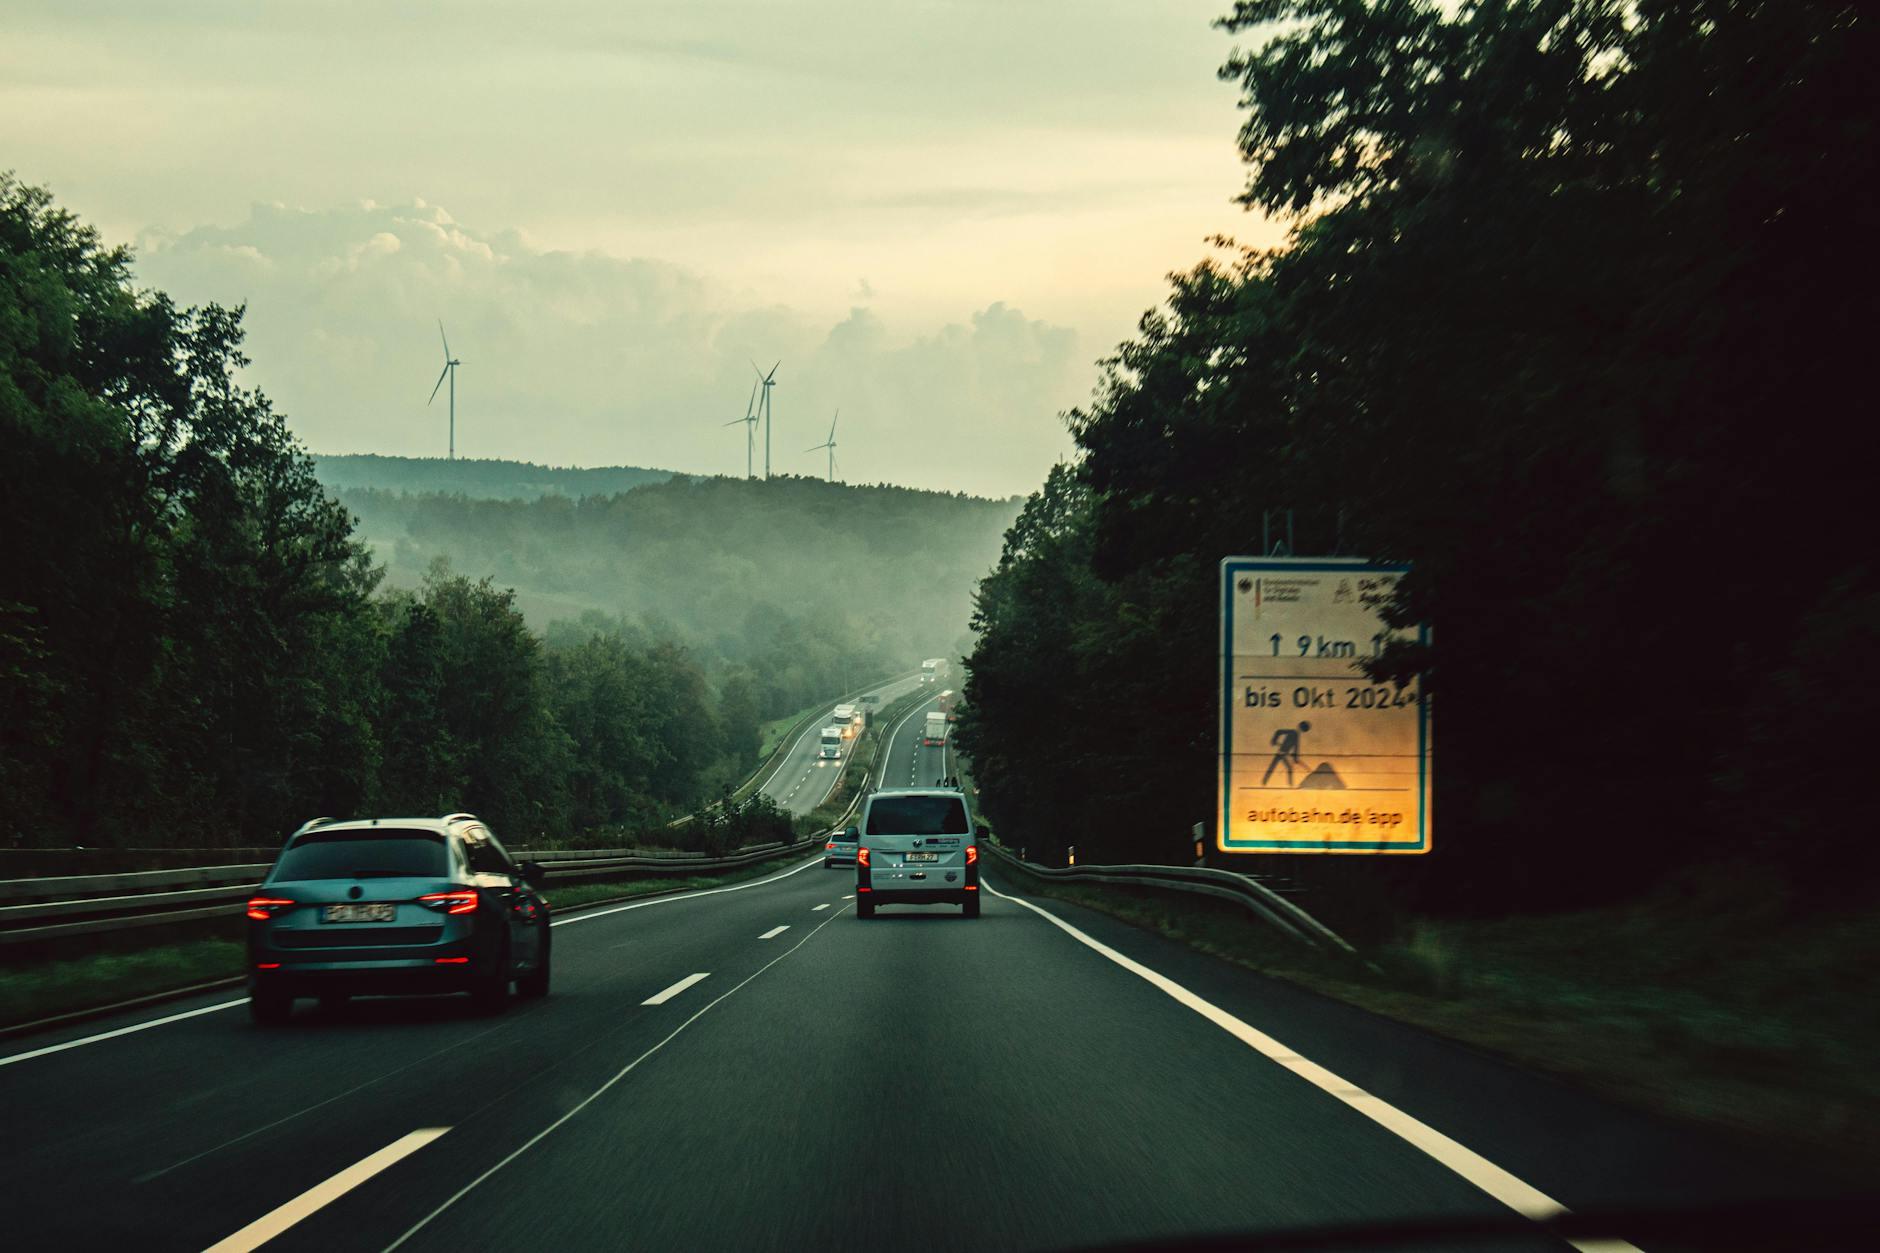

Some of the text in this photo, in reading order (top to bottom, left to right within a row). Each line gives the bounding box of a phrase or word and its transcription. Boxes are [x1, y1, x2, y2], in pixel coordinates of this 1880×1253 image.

[1296, 634, 1356, 658] 9 km
[1244, 686, 1281, 708] bis
[1292, 687, 1335, 708] Okt
